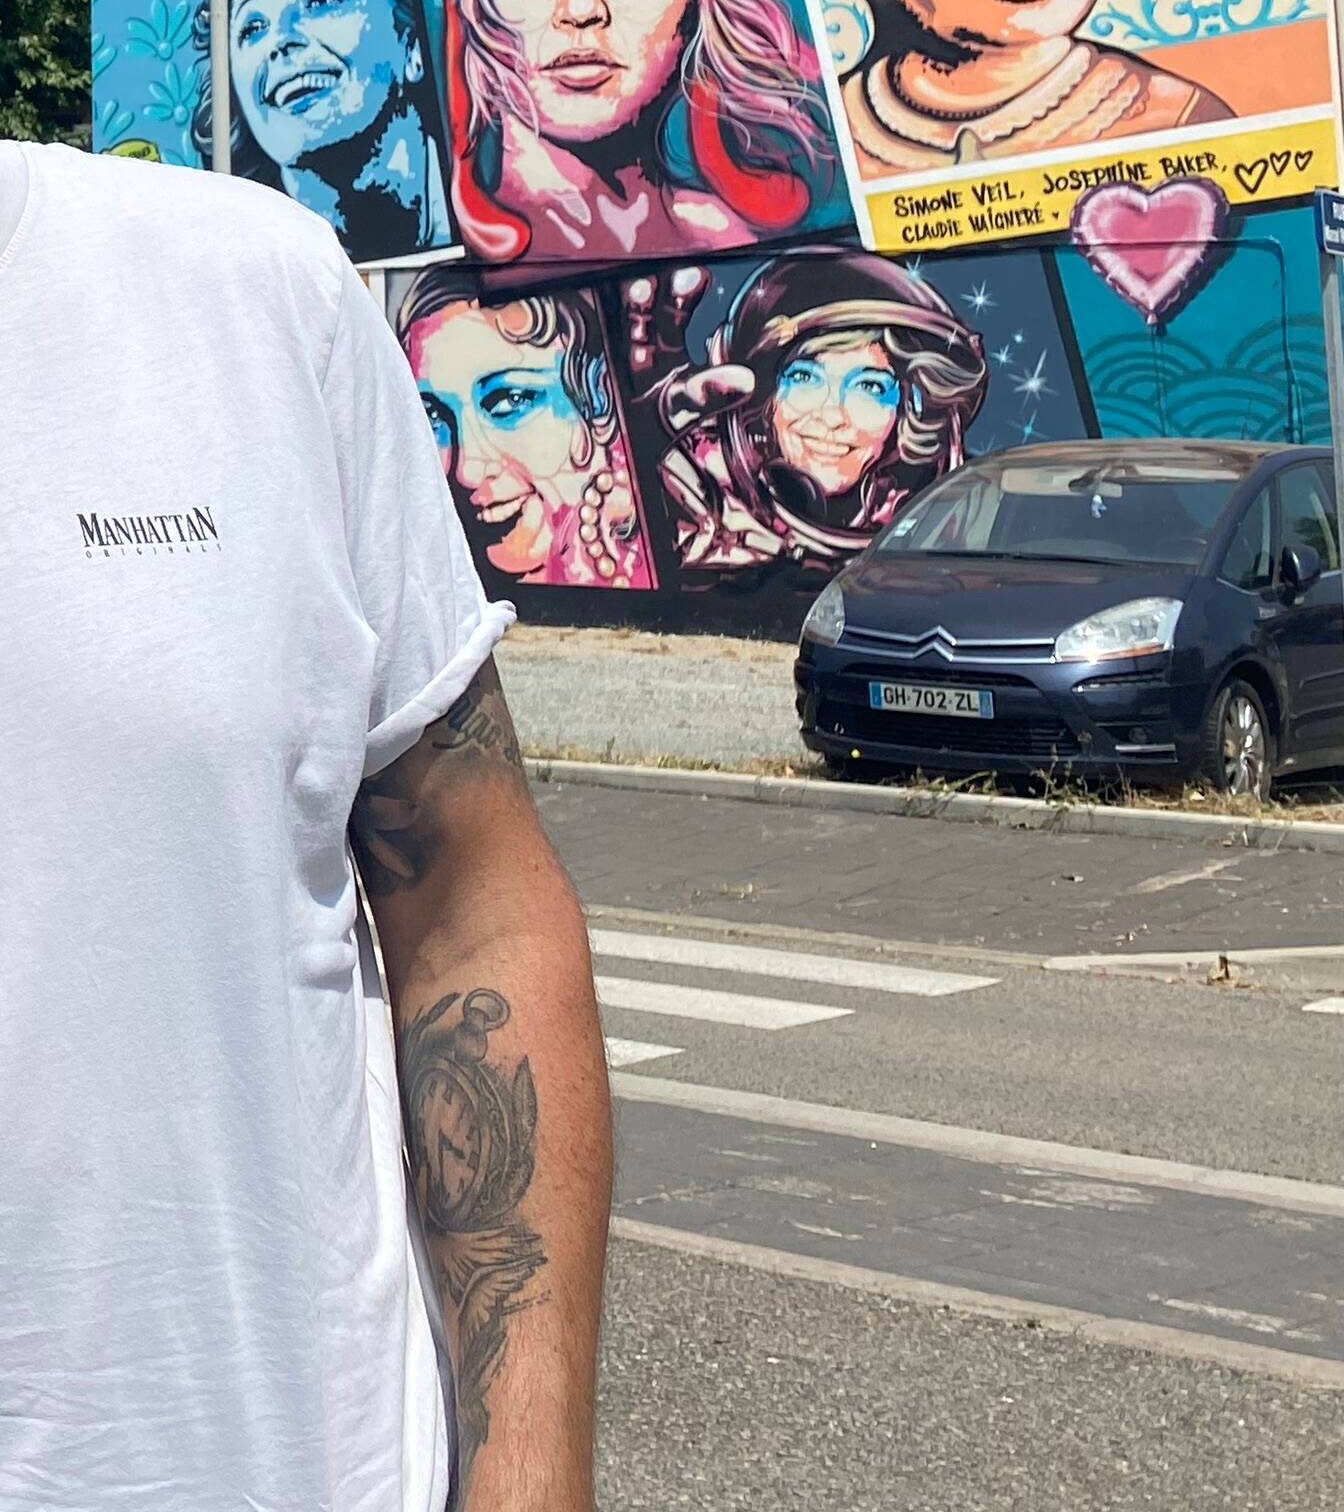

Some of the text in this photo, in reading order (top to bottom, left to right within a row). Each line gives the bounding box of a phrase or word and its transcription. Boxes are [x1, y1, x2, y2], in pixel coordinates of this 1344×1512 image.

[893, 189, 963, 218] SIMONE
[901, 218, 963, 245] CLAUDIE
[75, 505, 219, 548] MANHATTAN
